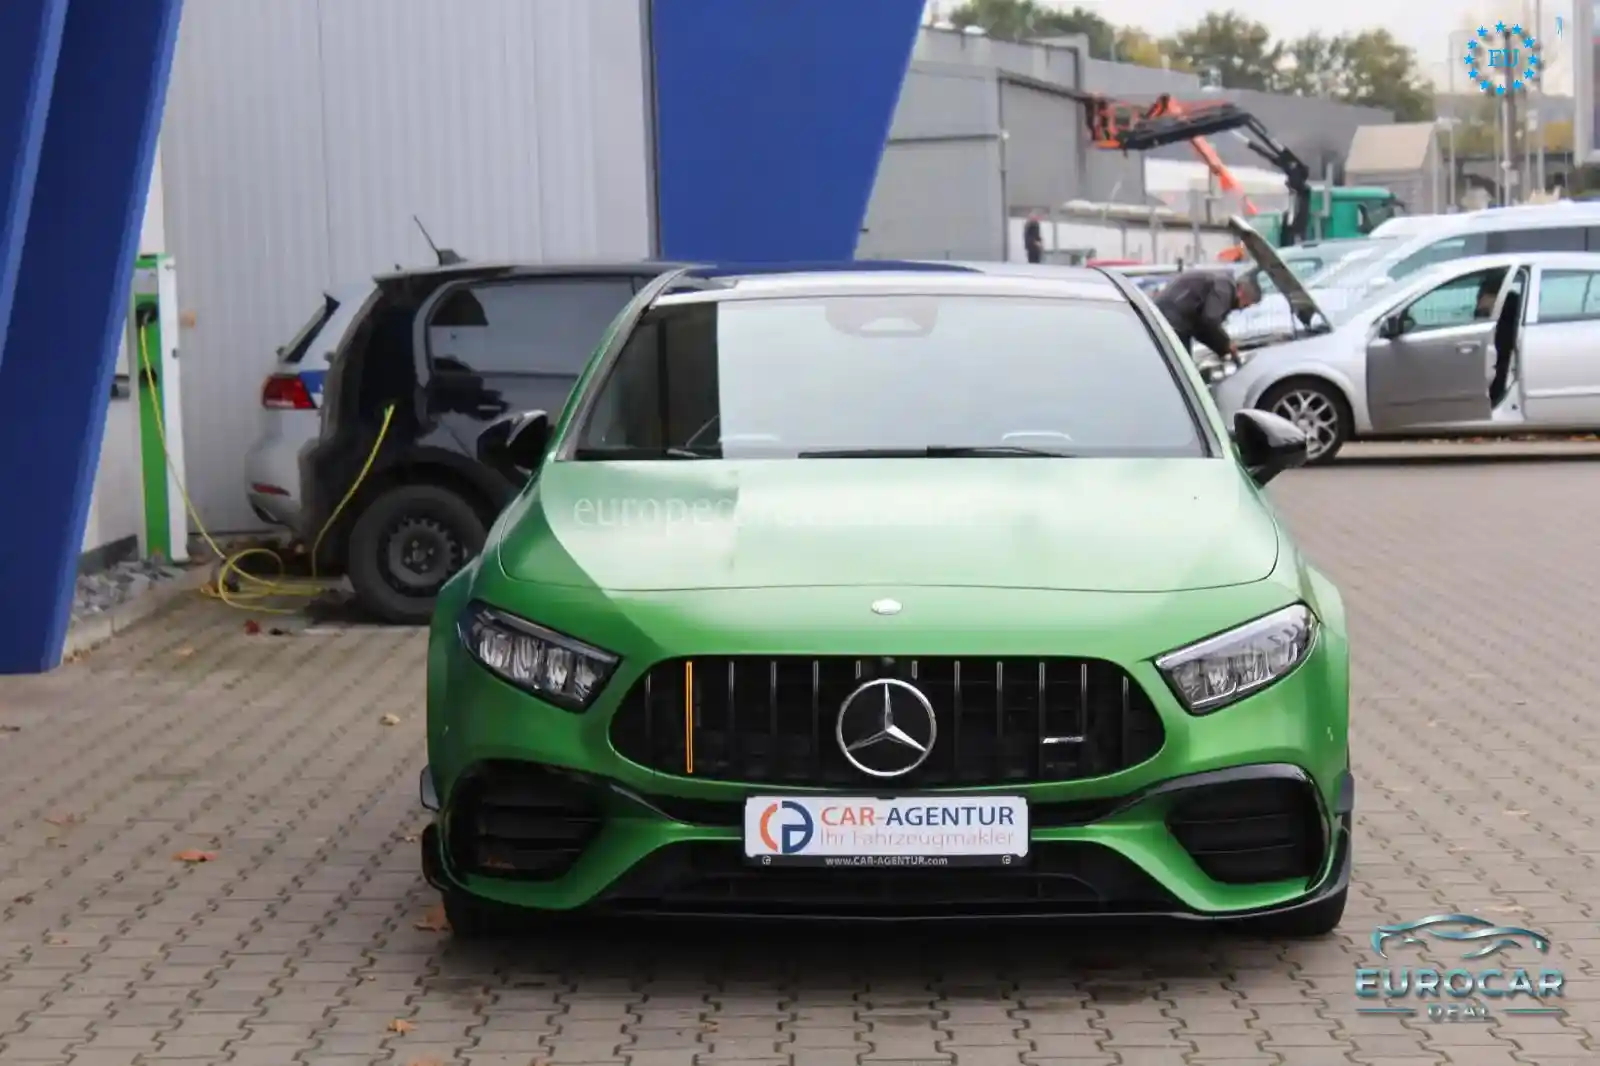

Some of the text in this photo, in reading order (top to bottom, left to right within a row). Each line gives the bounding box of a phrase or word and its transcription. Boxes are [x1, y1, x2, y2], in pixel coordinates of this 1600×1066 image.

[820, 806, 1015, 827] CAR-AGENTUR
[820, 827, 1015, 850] Ihr Fahrzeugmakler
[824, 855, 948, 866] www.CAR-AGENTUR.com
